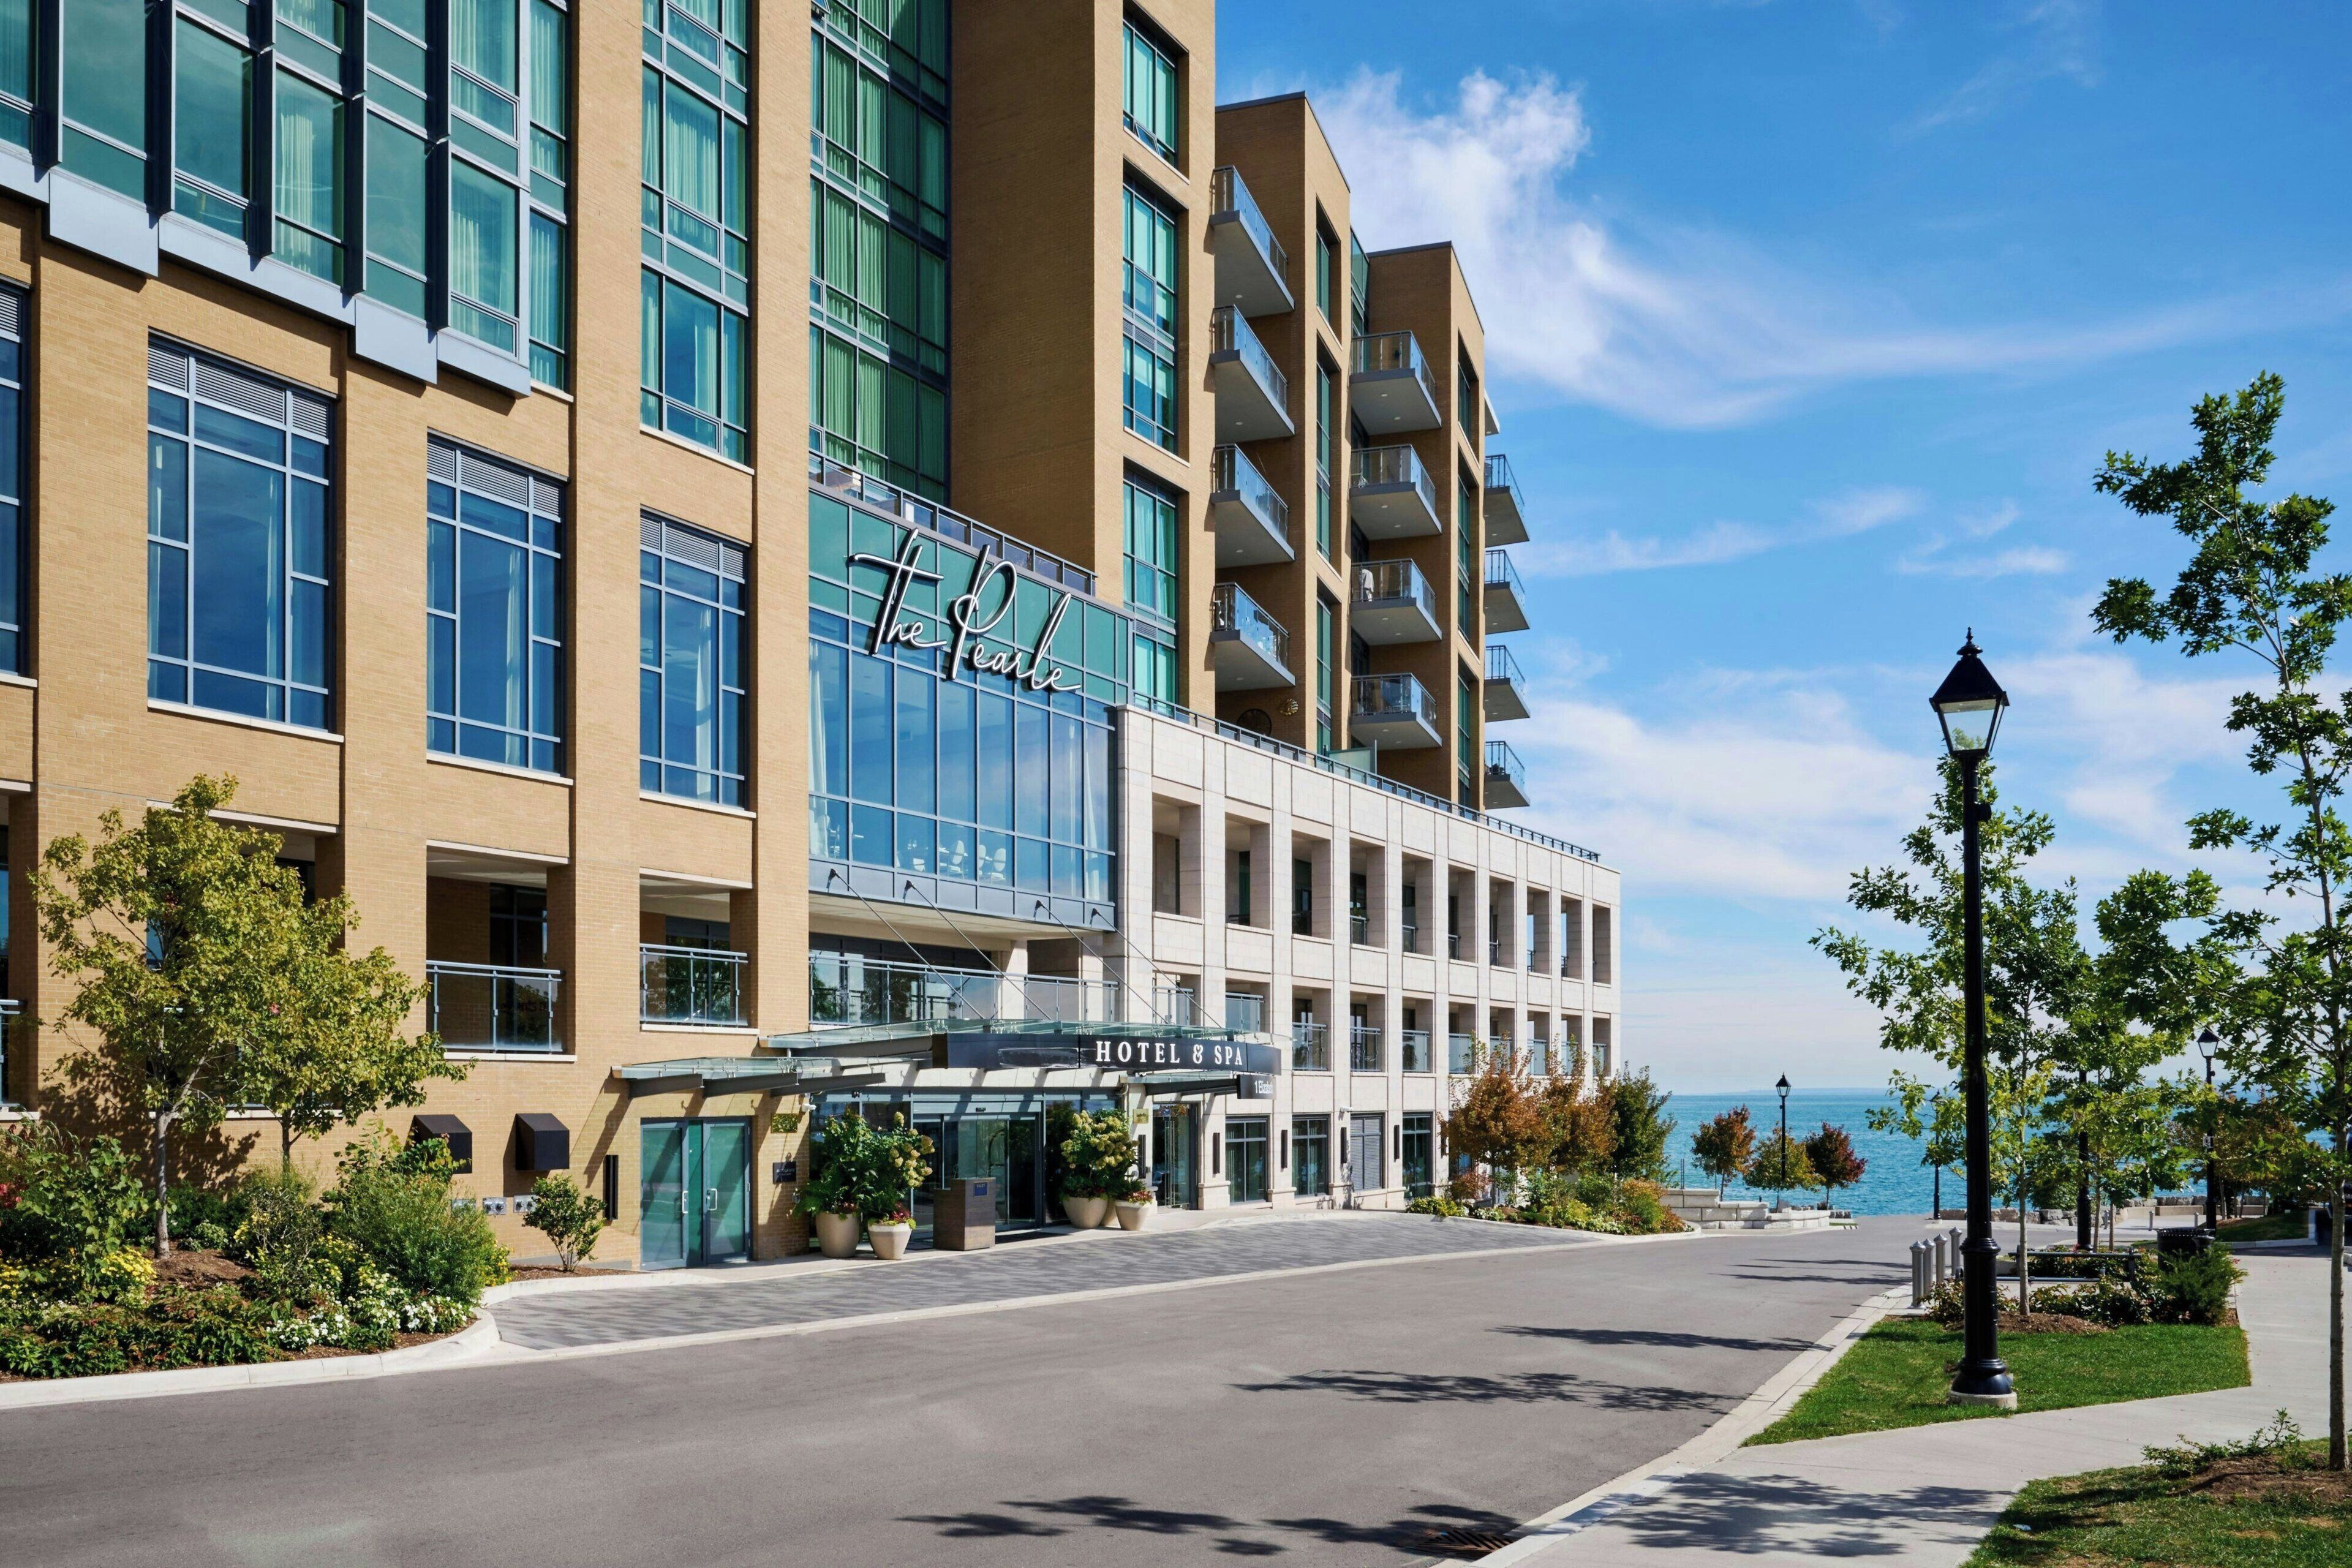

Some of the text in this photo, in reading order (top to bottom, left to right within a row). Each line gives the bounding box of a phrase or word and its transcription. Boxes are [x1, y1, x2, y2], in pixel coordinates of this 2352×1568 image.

[850, 527, 1081, 693] The Pearle
[1095, 1041, 1243, 1065] HOTEL & SPA
